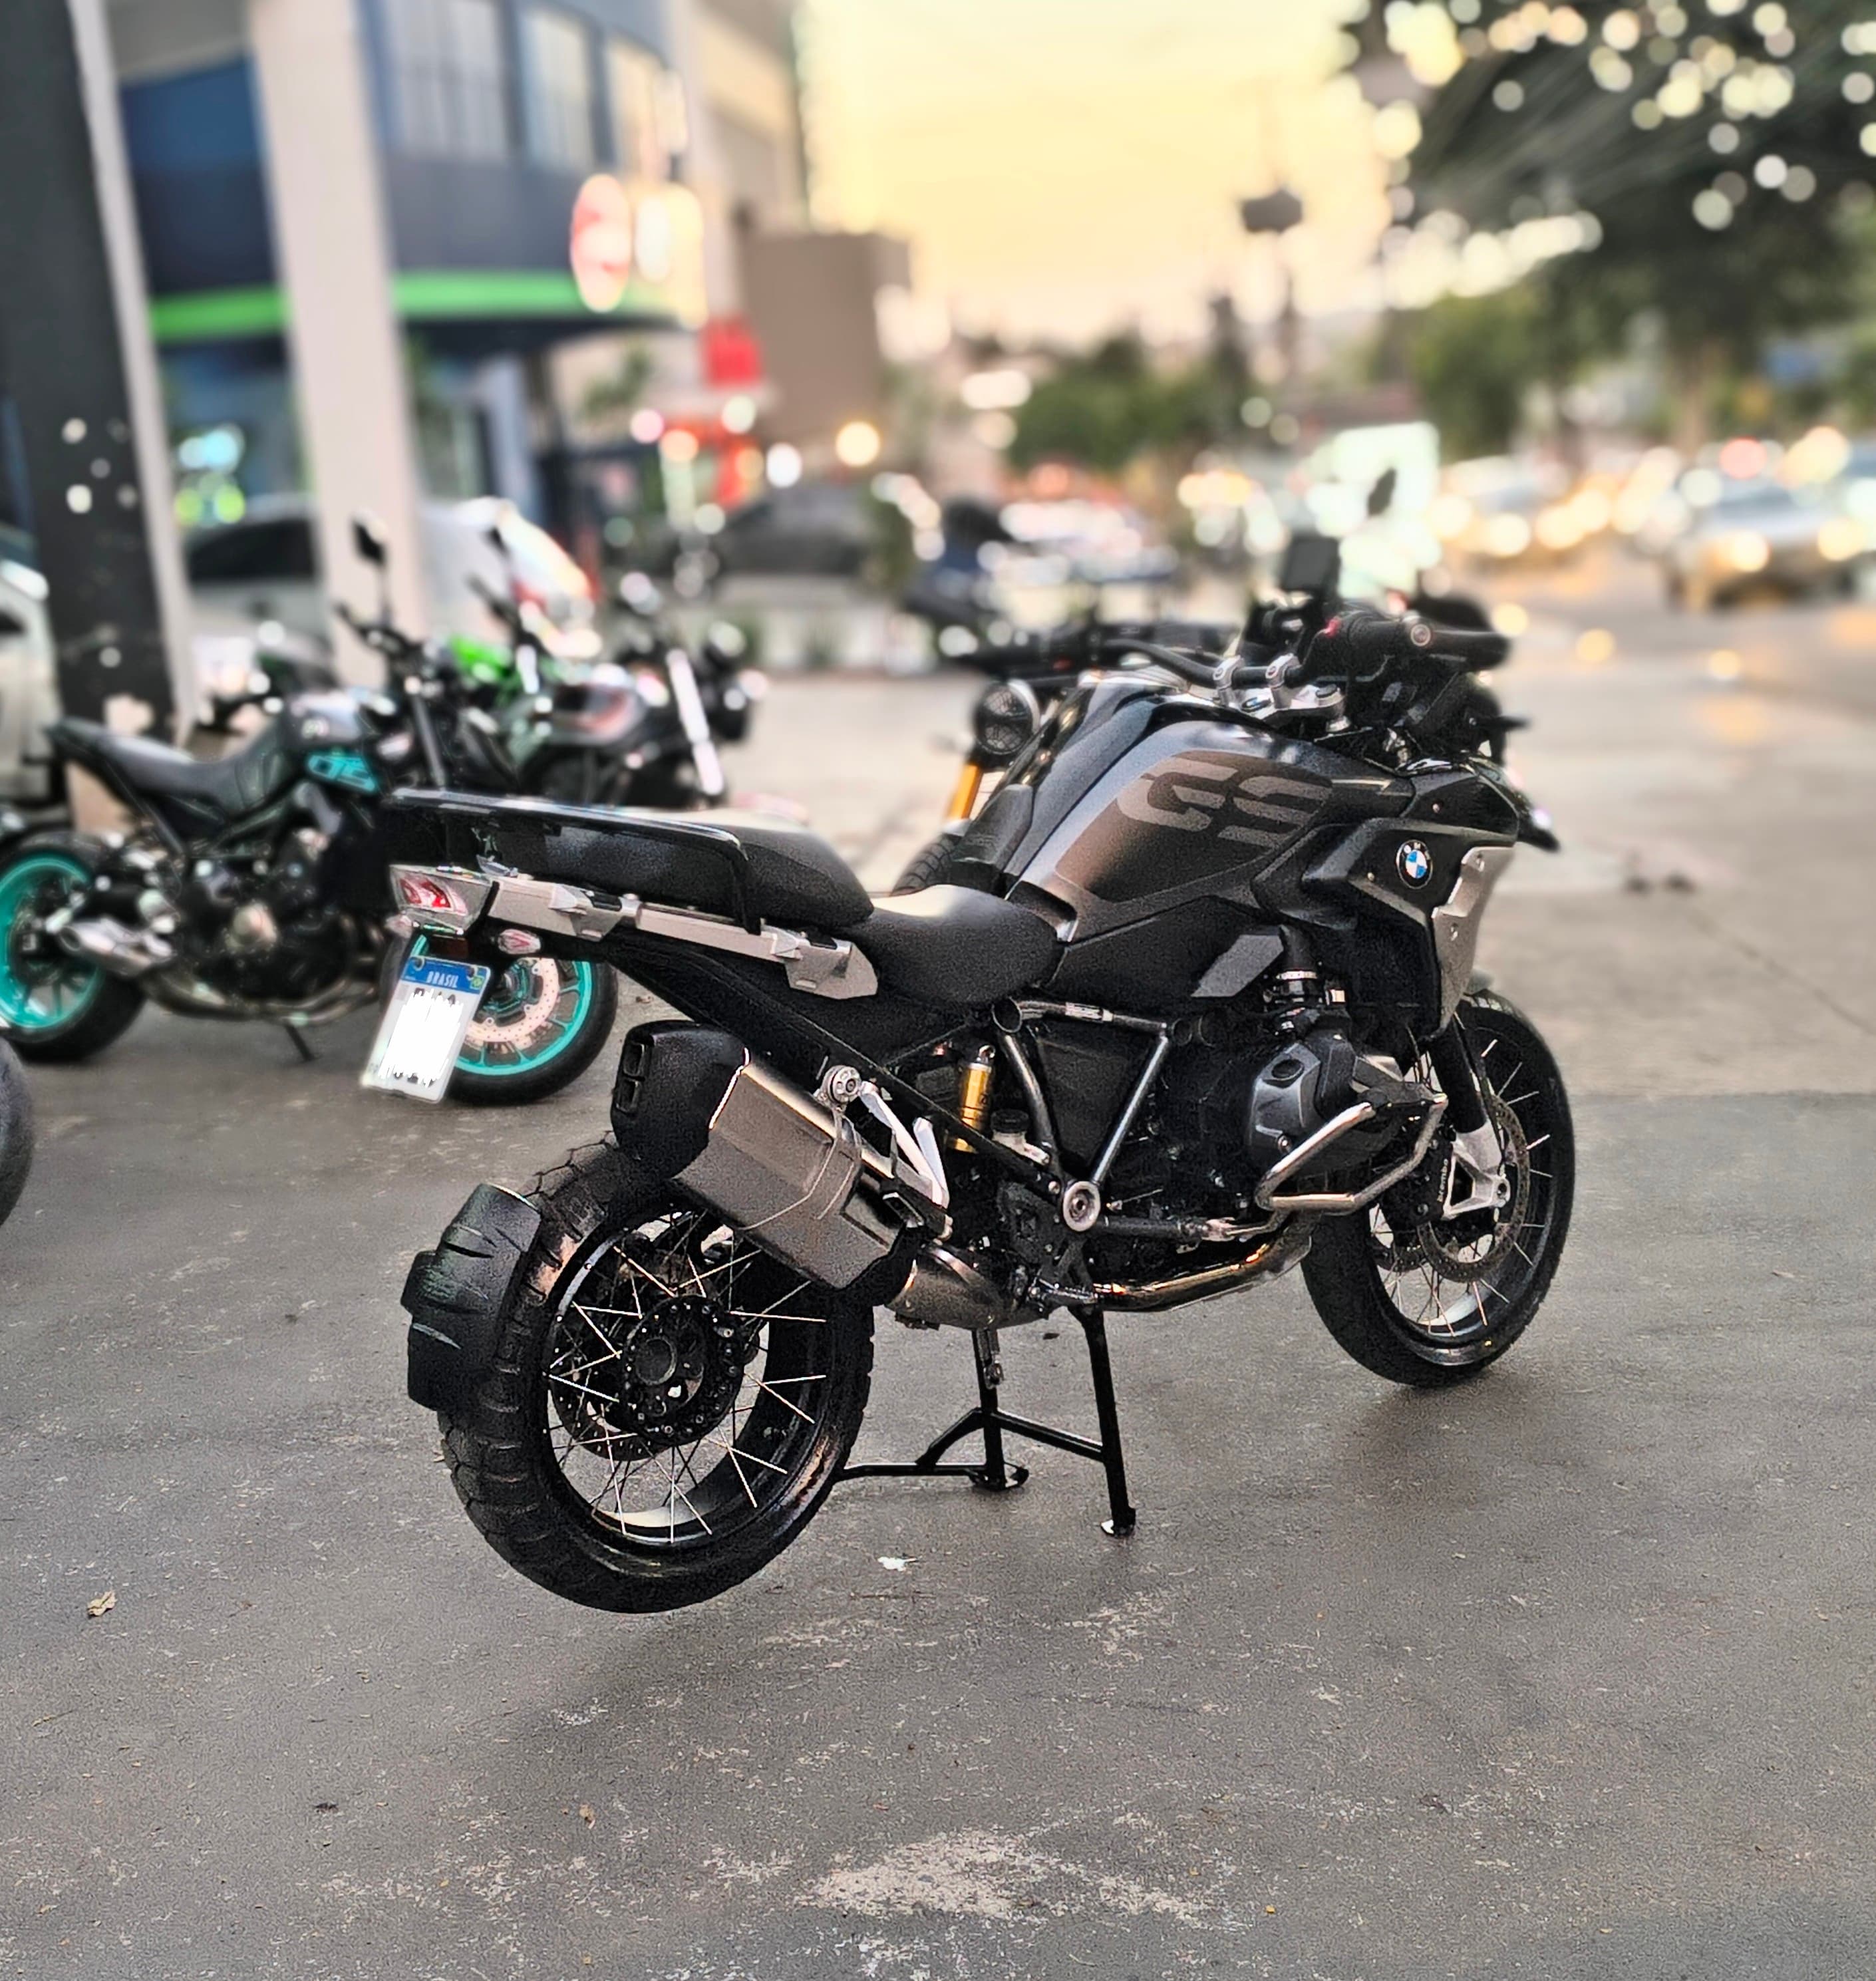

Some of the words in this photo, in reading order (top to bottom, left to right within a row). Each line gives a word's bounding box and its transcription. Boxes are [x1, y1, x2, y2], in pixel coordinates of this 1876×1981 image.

[1116, 756, 1331, 849] GS
[426, 971, 459, 988] BRASIL
[1437, 1158, 1448, 1203] brembo
